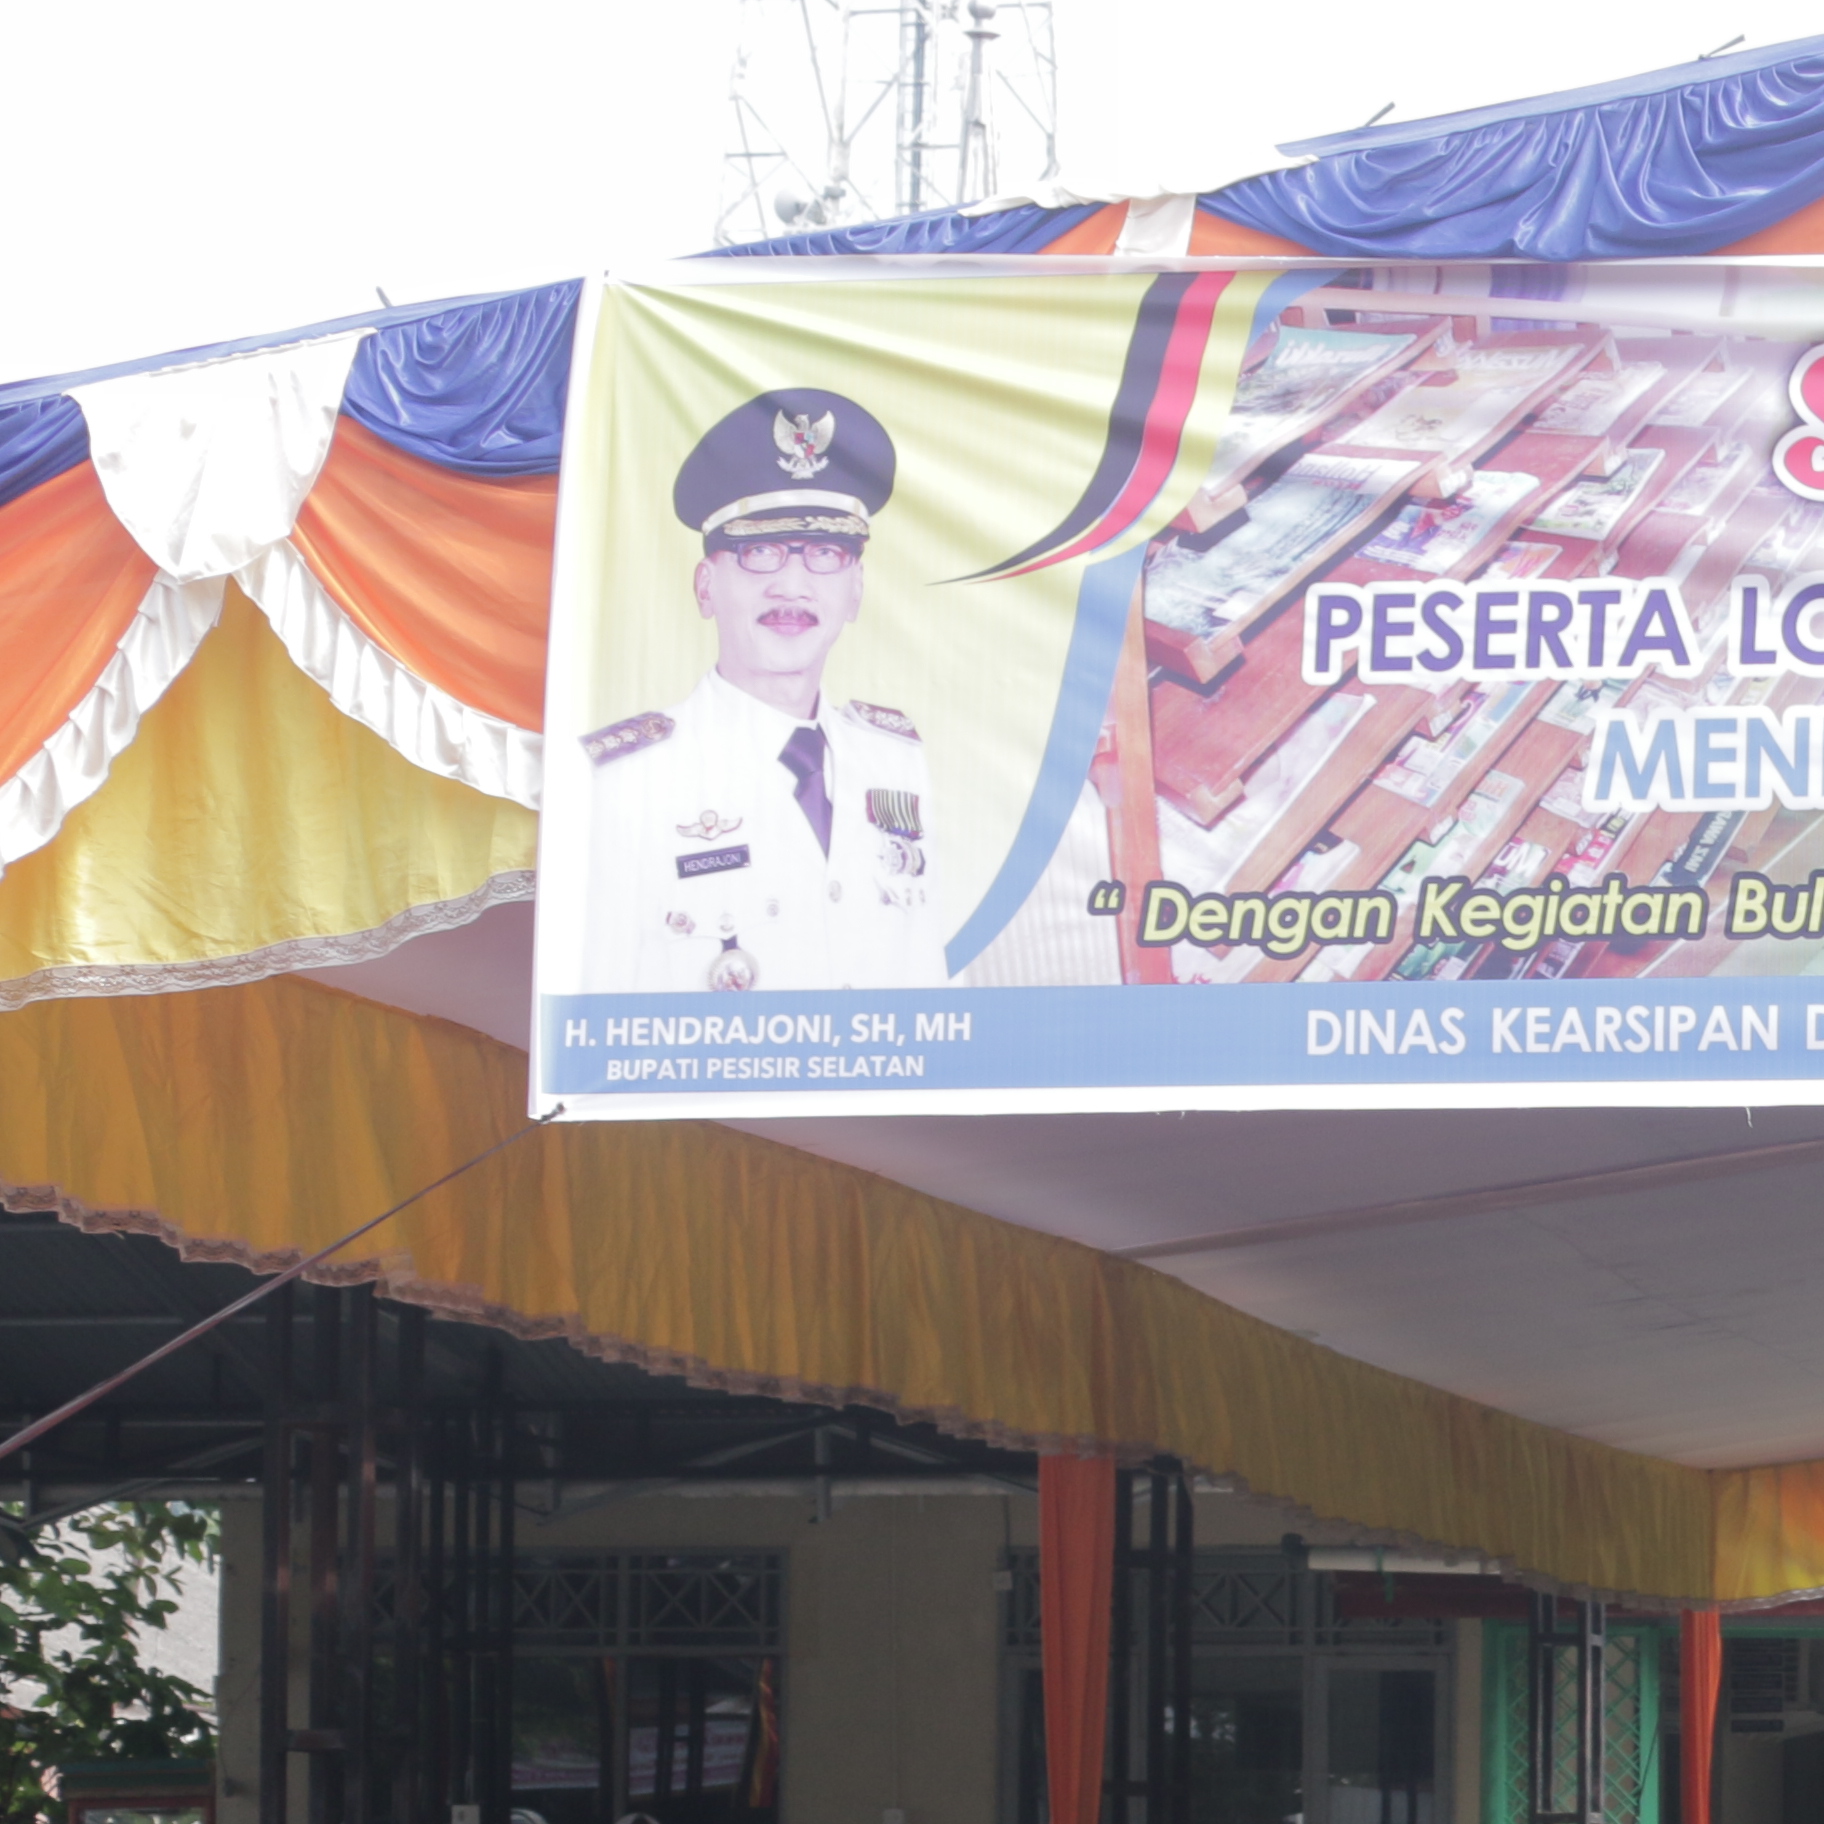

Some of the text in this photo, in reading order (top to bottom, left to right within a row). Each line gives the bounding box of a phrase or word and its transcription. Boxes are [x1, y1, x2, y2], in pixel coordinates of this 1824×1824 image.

[1314, 588, 1689, 673] PESERTA
[1141, 886, 1391, 956] Dengan
[1421, 881, 1701, 949] Kegiatan
[564, 1012, 972, 1047] H. HENDRAJONI, SH, MH
[1307, 1009, 1467, 1057] DINAS
[1491, 1008, 1778, 1055] KEARSIPAN
[606, 1054, 925, 1082] BUPATI PESISIR SELATAN
